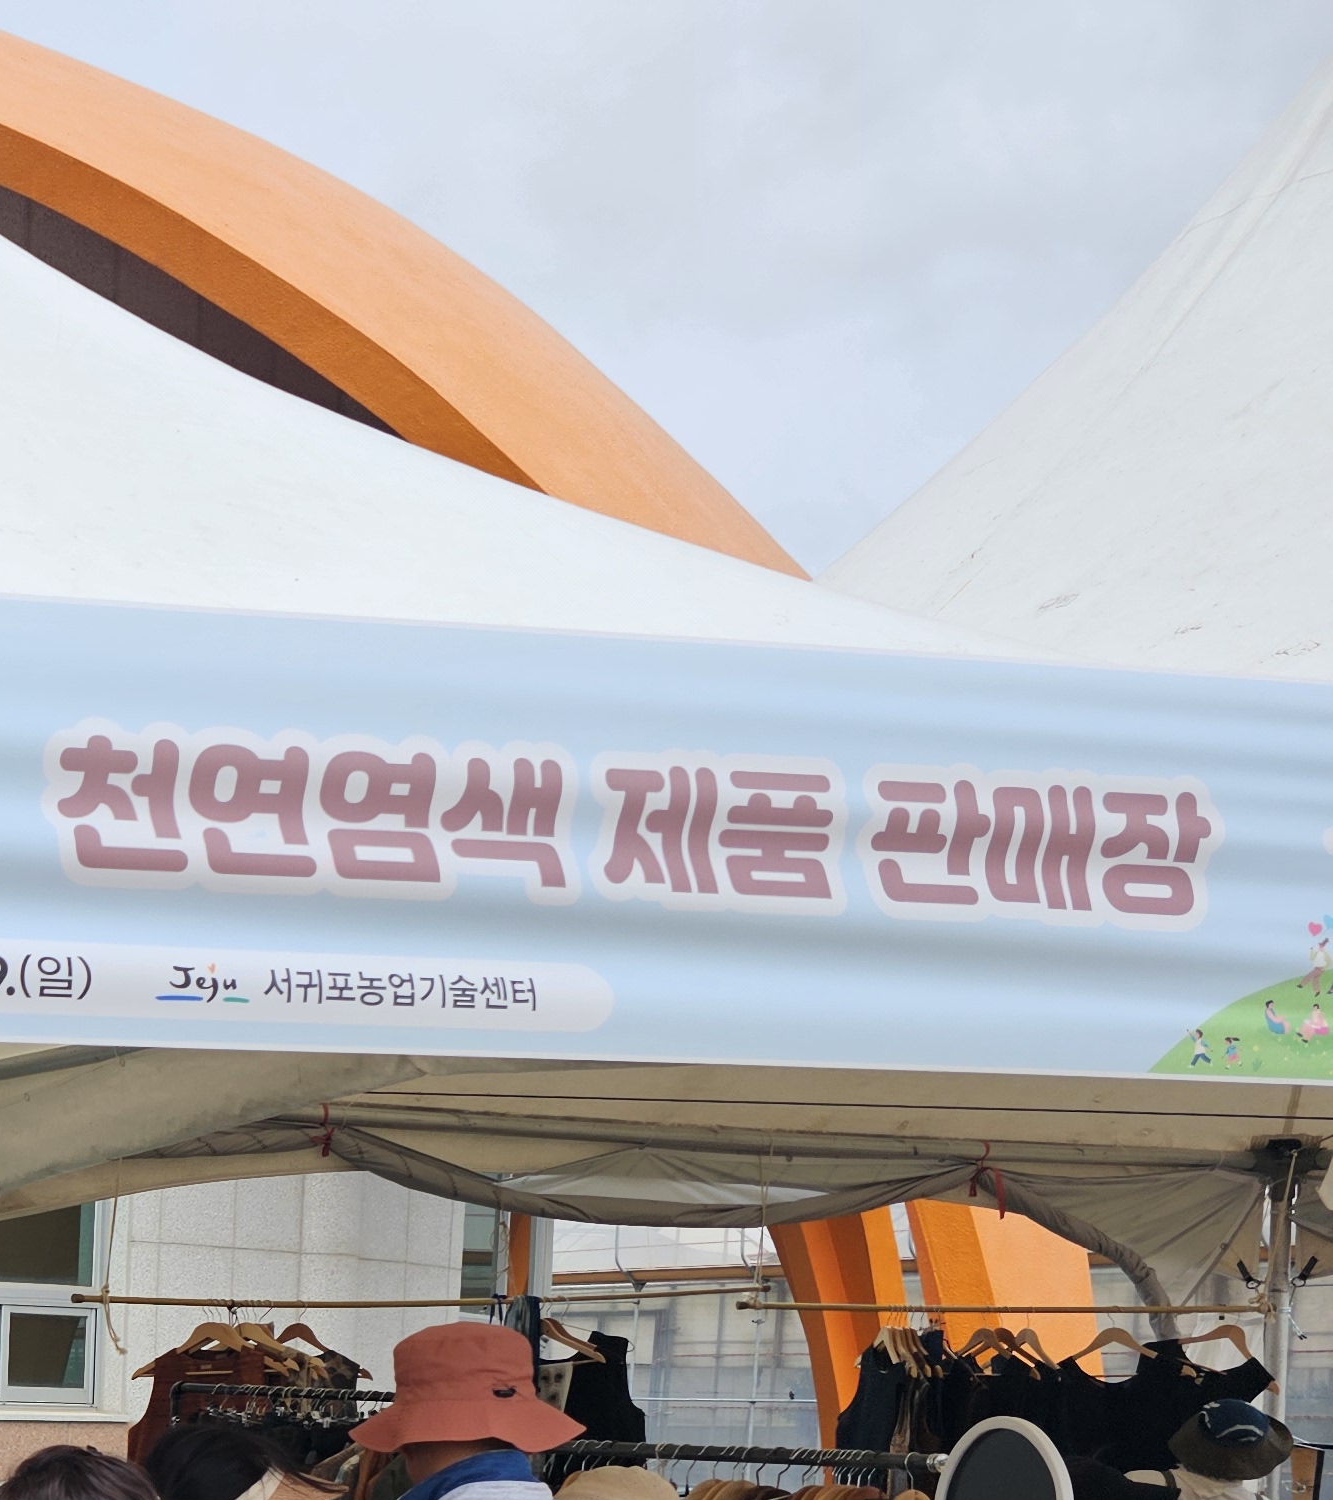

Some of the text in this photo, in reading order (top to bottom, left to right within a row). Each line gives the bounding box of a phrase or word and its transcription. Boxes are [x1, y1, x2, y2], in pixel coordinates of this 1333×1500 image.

[57, 734, 567, 889] 천연염색
[603, 765, 834, 900] 제품
[870, 778, 1211, 917] 판매장
[169, 963, 237, 1003] Jeju
[263, 968, 537, 1012] 서귀포농업기술센터
